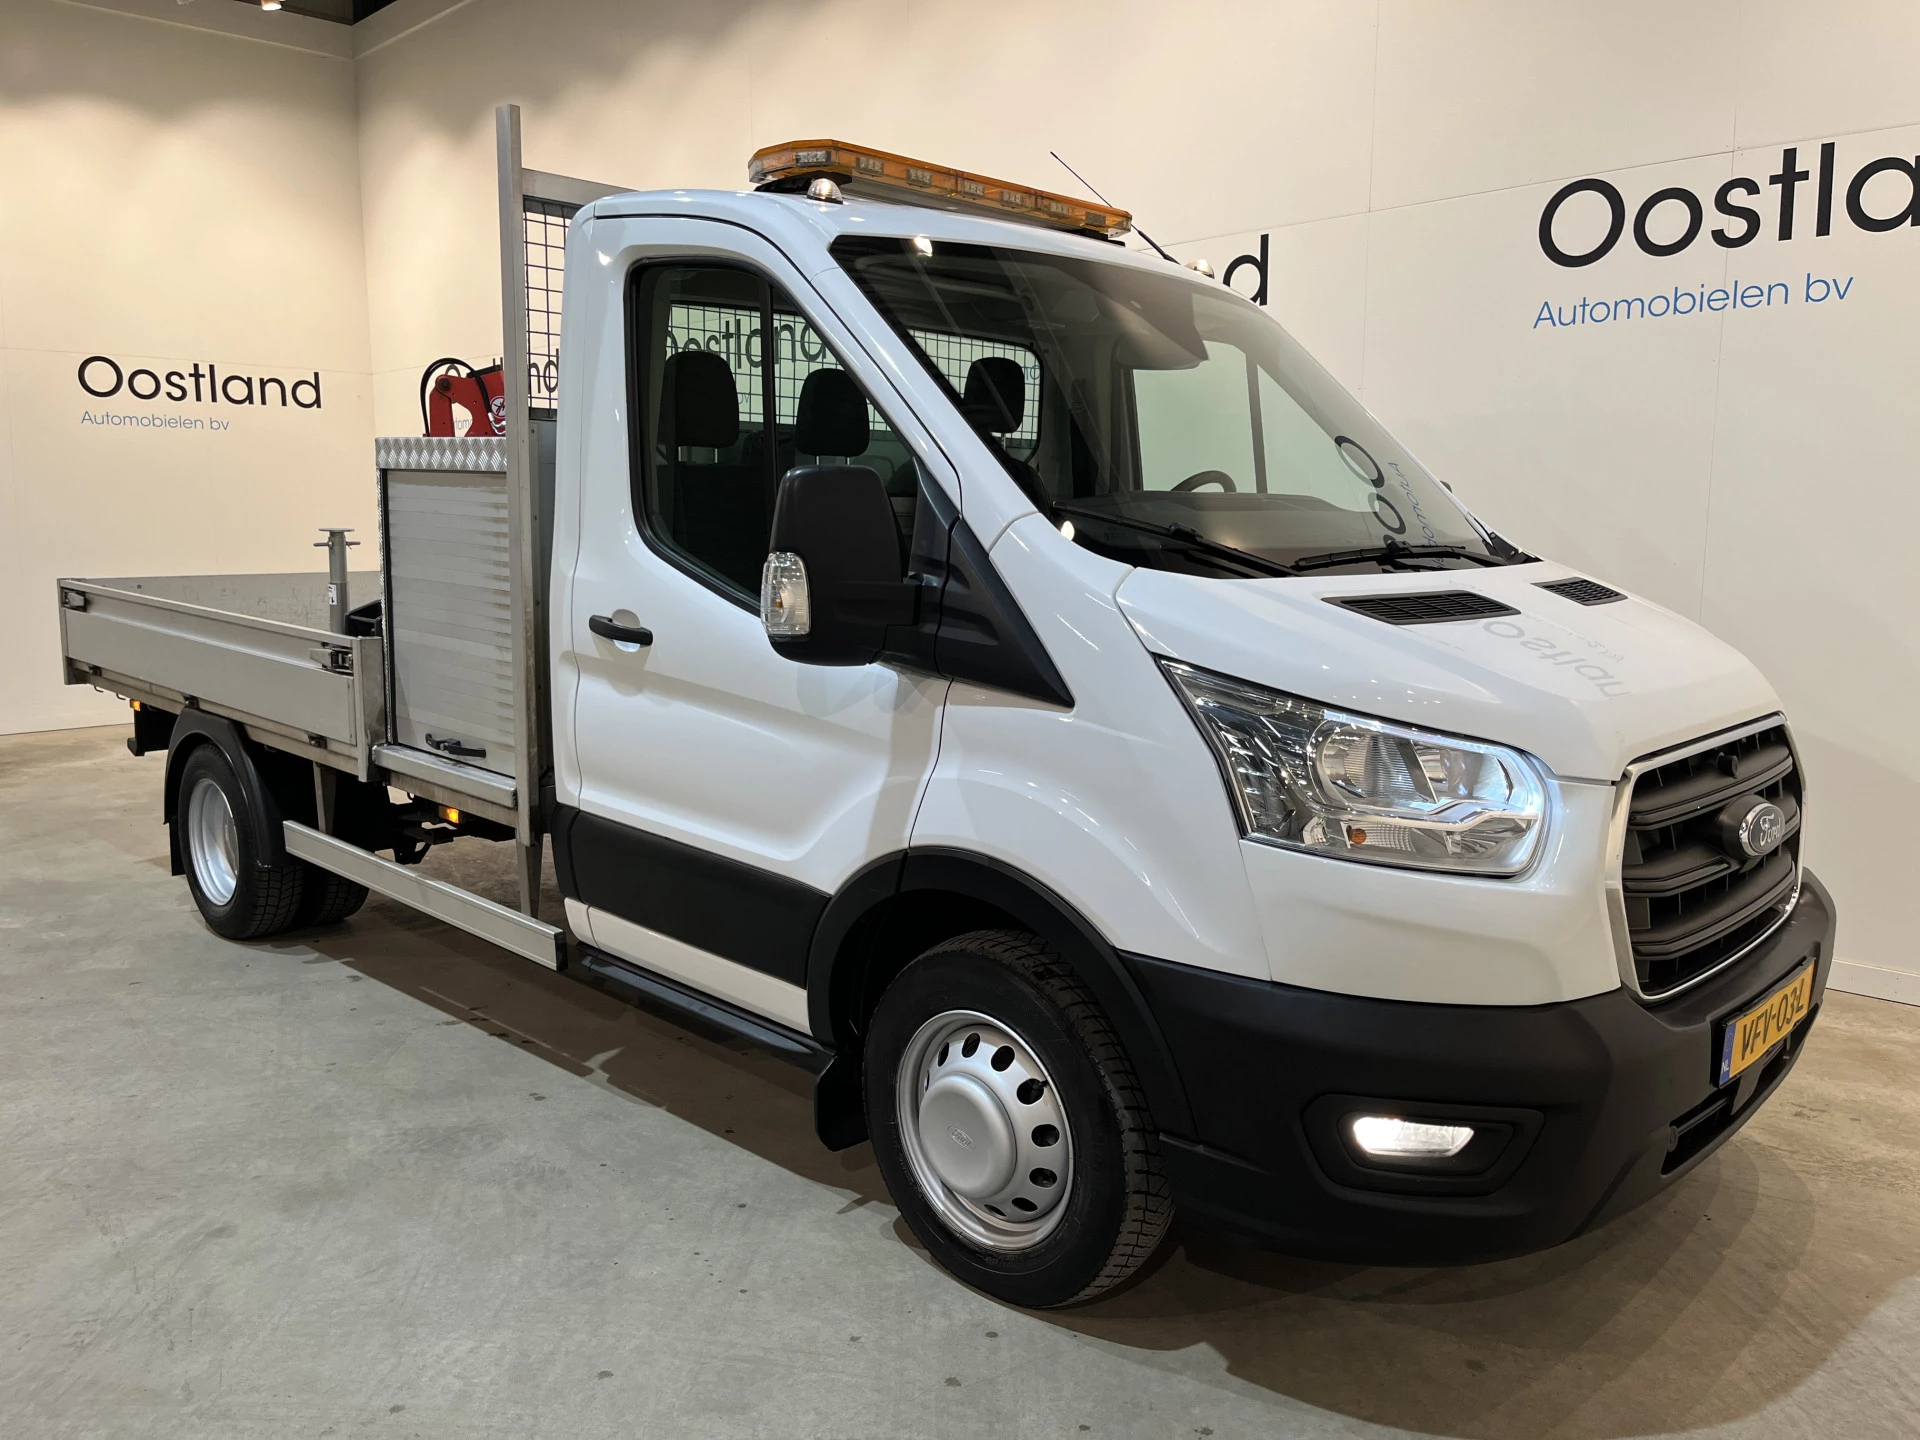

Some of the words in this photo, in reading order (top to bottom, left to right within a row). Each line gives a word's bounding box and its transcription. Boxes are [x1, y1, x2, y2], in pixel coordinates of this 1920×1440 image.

[1533, 280, 1790, 330] Automobielen
[1804, 272, 1854, 304] bv
[78, 355, 322, 409] Oostland
[81, 410, 205, 430] Automobielen
[209, 416, 230, 432] bv
[1759, 813, 1781, 847] Ford
[1721, 1059, 1730, 1074] NL
